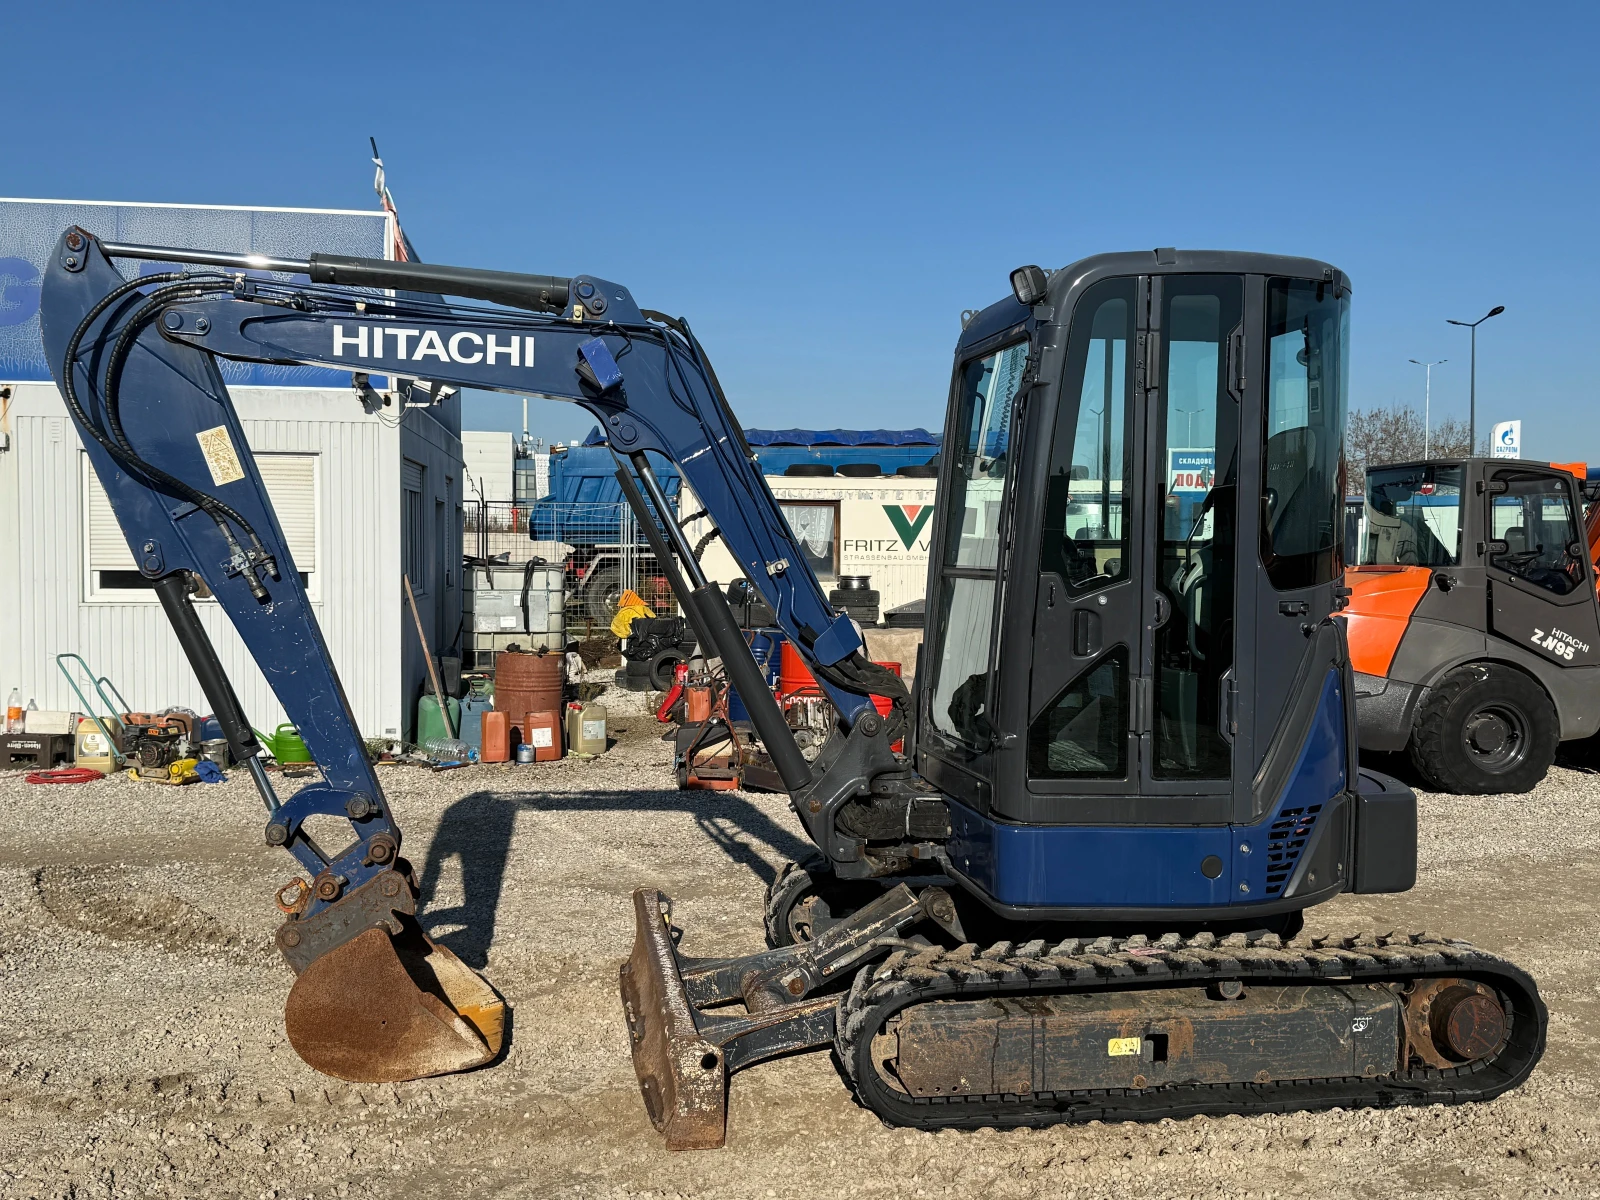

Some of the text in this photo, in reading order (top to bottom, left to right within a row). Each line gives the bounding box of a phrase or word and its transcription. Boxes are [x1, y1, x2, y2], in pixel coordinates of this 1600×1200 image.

[333, 325, 535, 368] HITACHI
[1178, 458, 1213, 466] СКЛАДОВЕ
[844, 540, 899, 552] FRITZ
[1551, 627, 1590, 653] HITACHI
